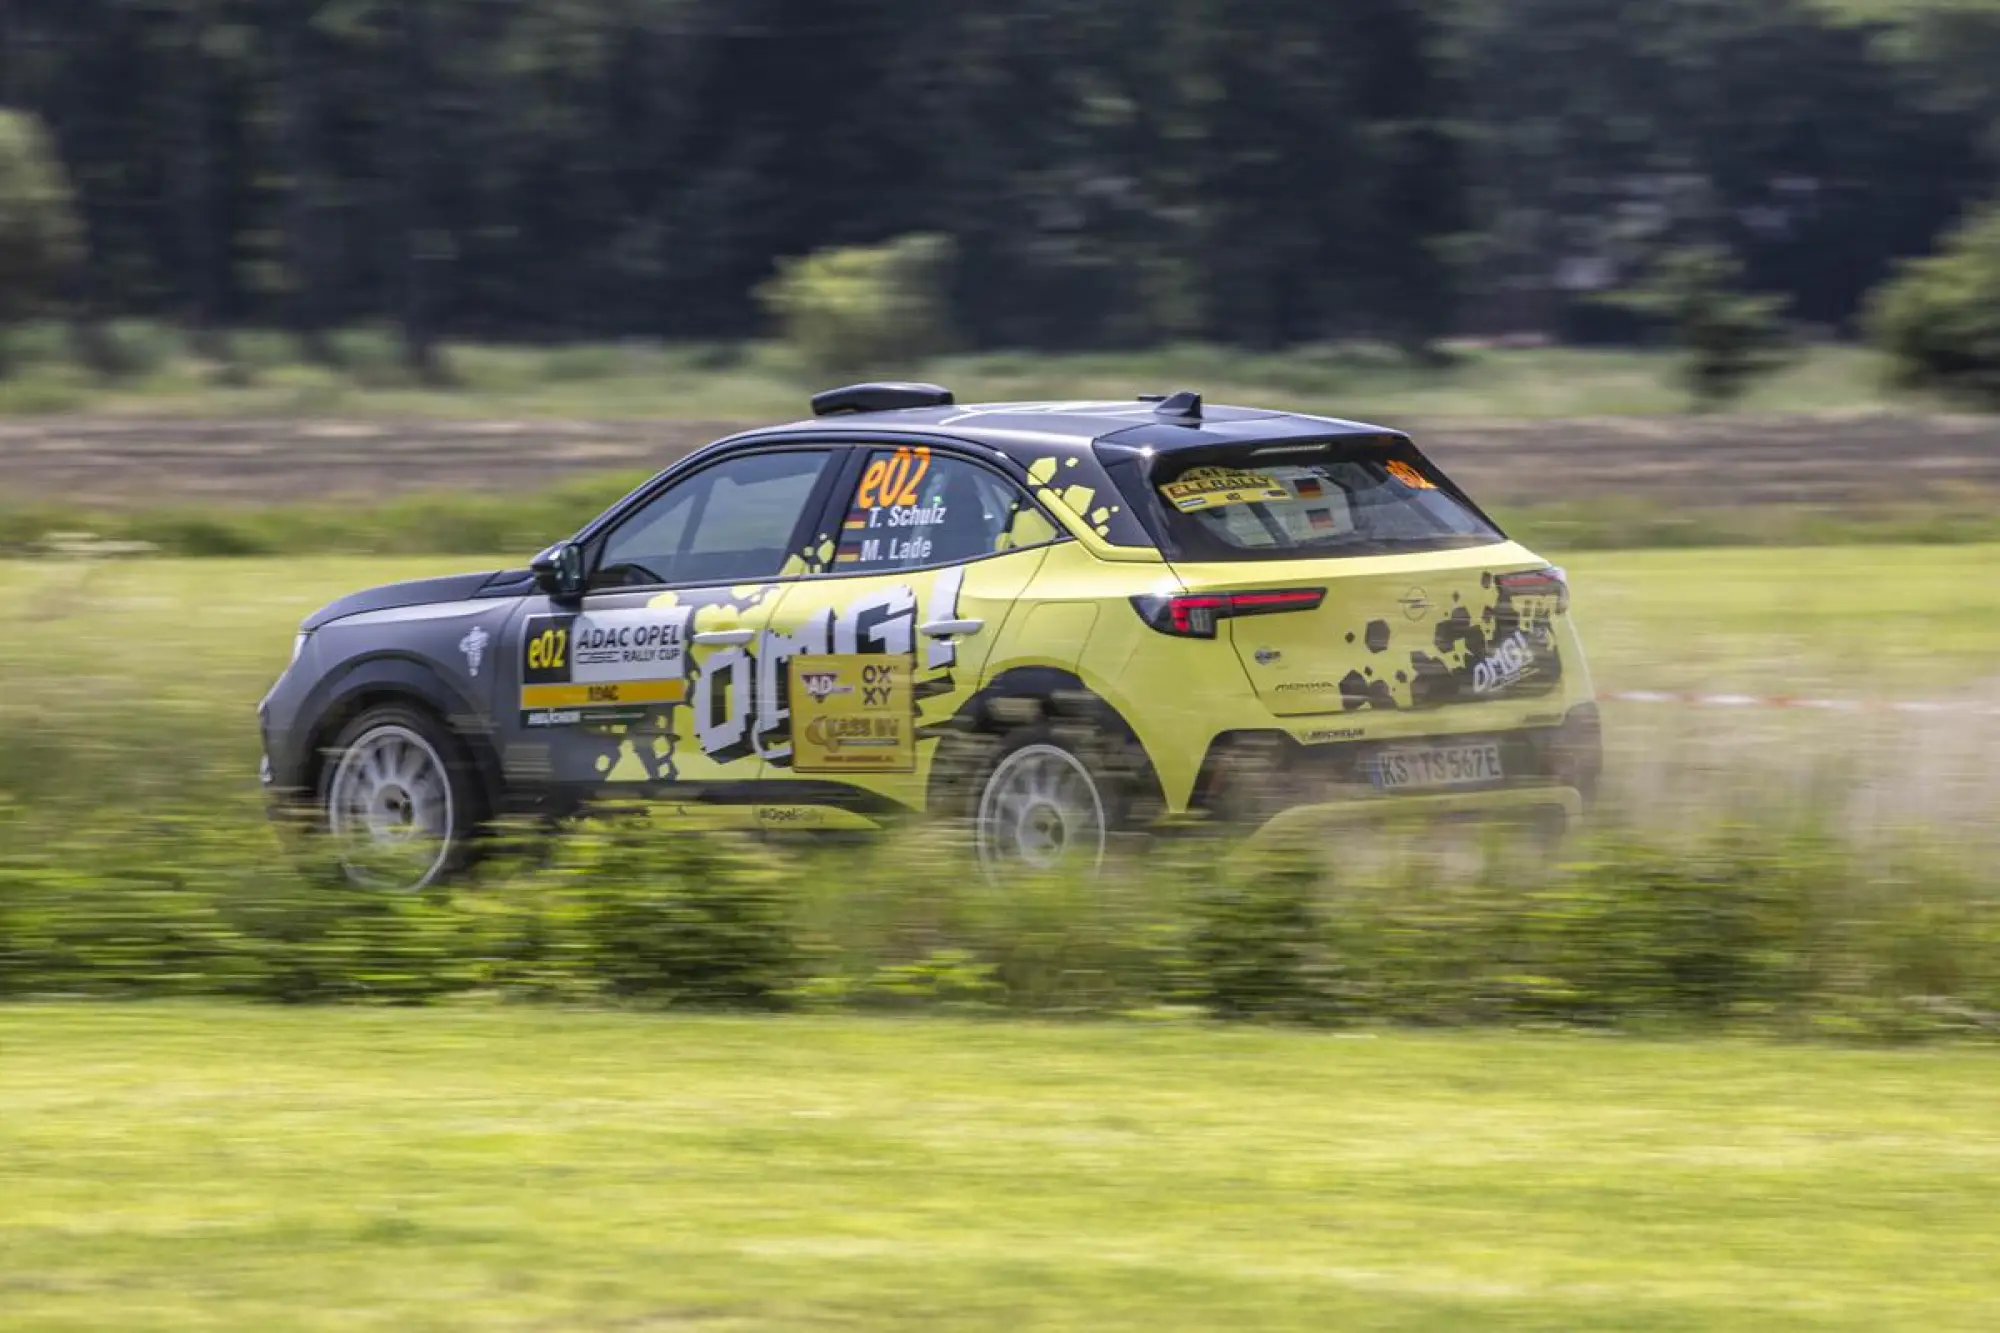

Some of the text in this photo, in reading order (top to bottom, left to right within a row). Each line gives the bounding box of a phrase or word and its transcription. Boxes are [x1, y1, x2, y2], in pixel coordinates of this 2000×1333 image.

[857, 446, 931, 508] e02
[869, 503, 946, 528] T. Schulz
[860, 536, 932, 561] M. Lade
[528, 629, 568, 669] e02
[577, 624, 680, 649] ADAC OPEL
[623, 648, 680, 663] RALLY CUP
[1472, 631, 1534, 694] OMG!
[808, 675, 832, 695] AD
[863, 665, 892, 684] OX
[863, 687, 892, 705] XY
[1382, 754, 1408, 785] KS
